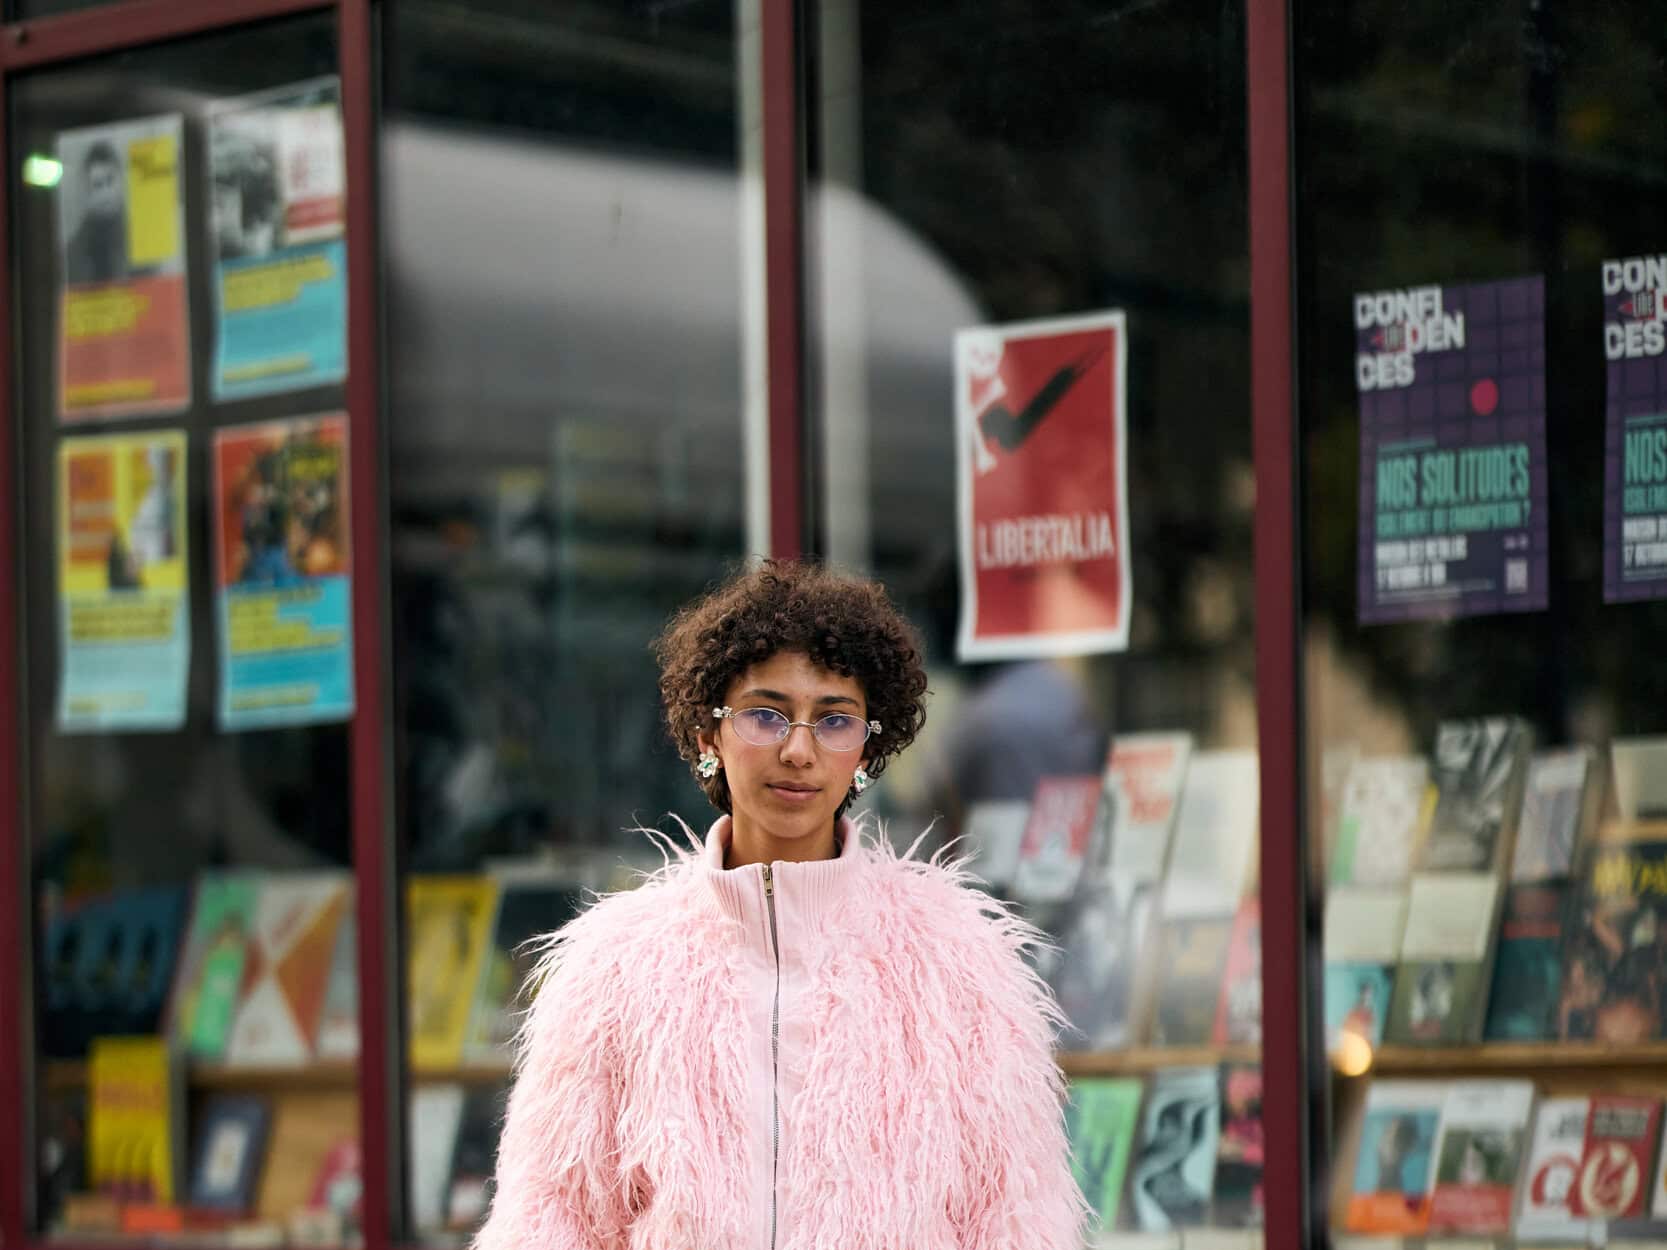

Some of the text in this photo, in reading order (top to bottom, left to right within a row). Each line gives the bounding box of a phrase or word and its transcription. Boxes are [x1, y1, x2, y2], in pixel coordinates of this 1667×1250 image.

[1356, 288, 1442, 328] CONFI
[1406, 311, 1465, 353] DEN
[1605, 321, 1666, 359] CES
[1358, 353, 1415, 391] CES
[1377, 443, 1530, 510] NOS SOLITUDES
[1625, 428, 1667, 484] NOS
[978, 511, 1115, 570] LIBERTALIA
